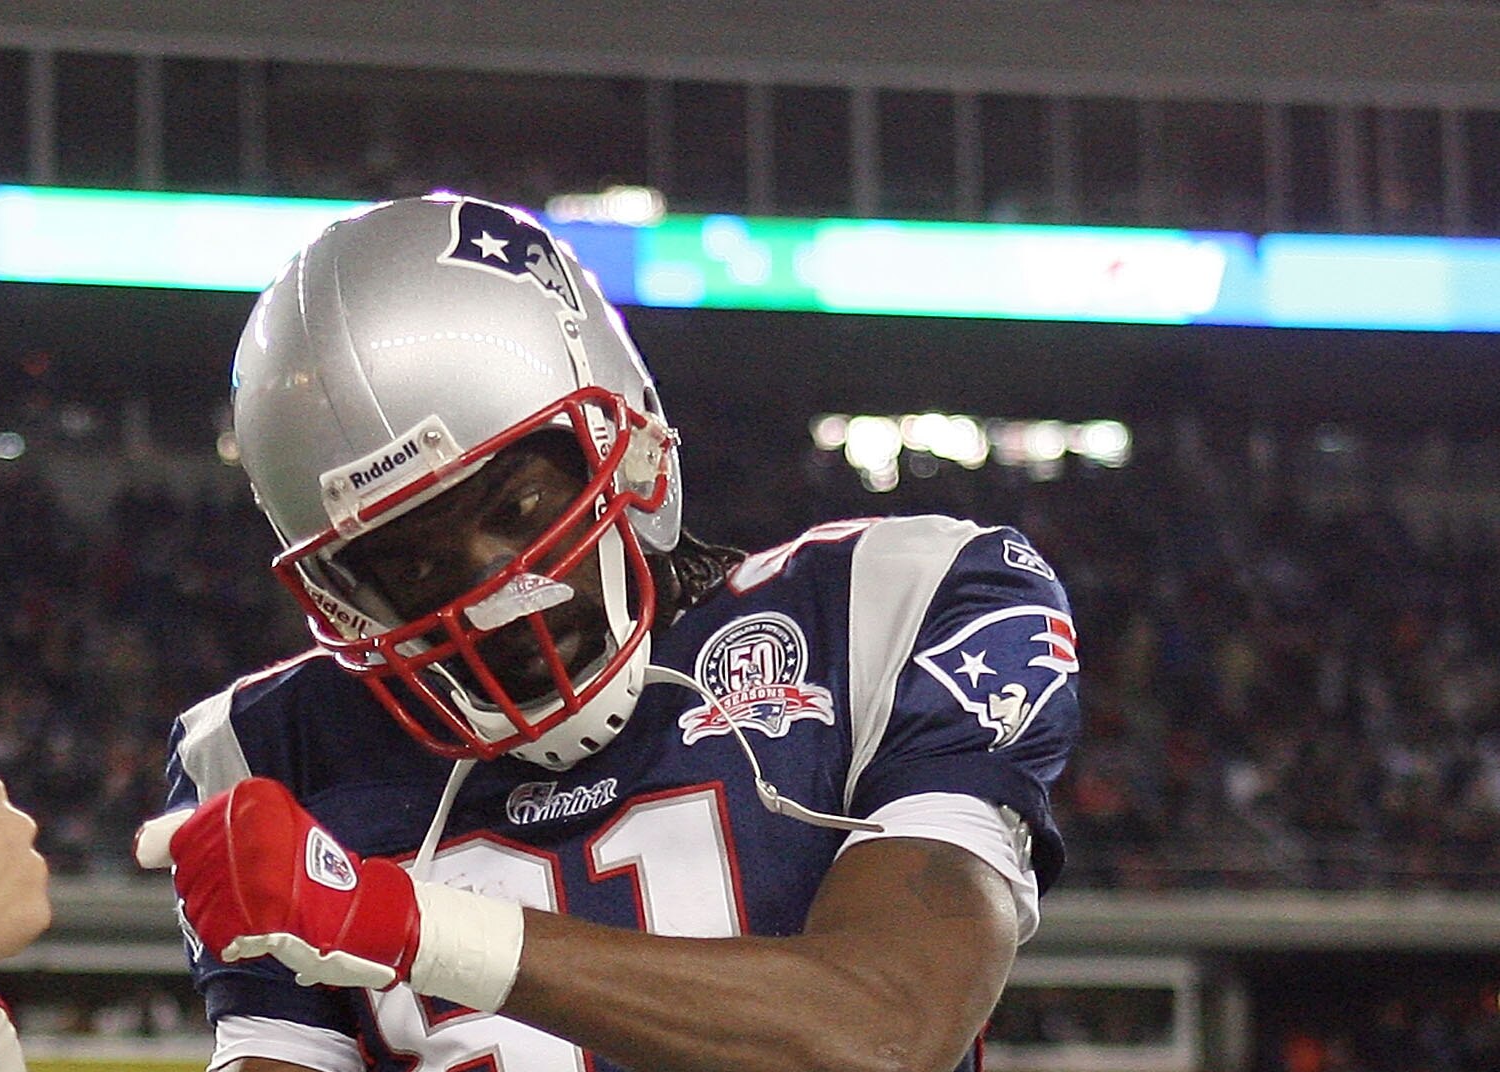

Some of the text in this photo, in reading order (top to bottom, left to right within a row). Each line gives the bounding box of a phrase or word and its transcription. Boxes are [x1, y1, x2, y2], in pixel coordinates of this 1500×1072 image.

[349, 439, 420, 489] Riddell
[728, 639, 778, 693] 50
[724, 688, 786, 708] SEASONS
[506, 778, 618, 825] Patriots
